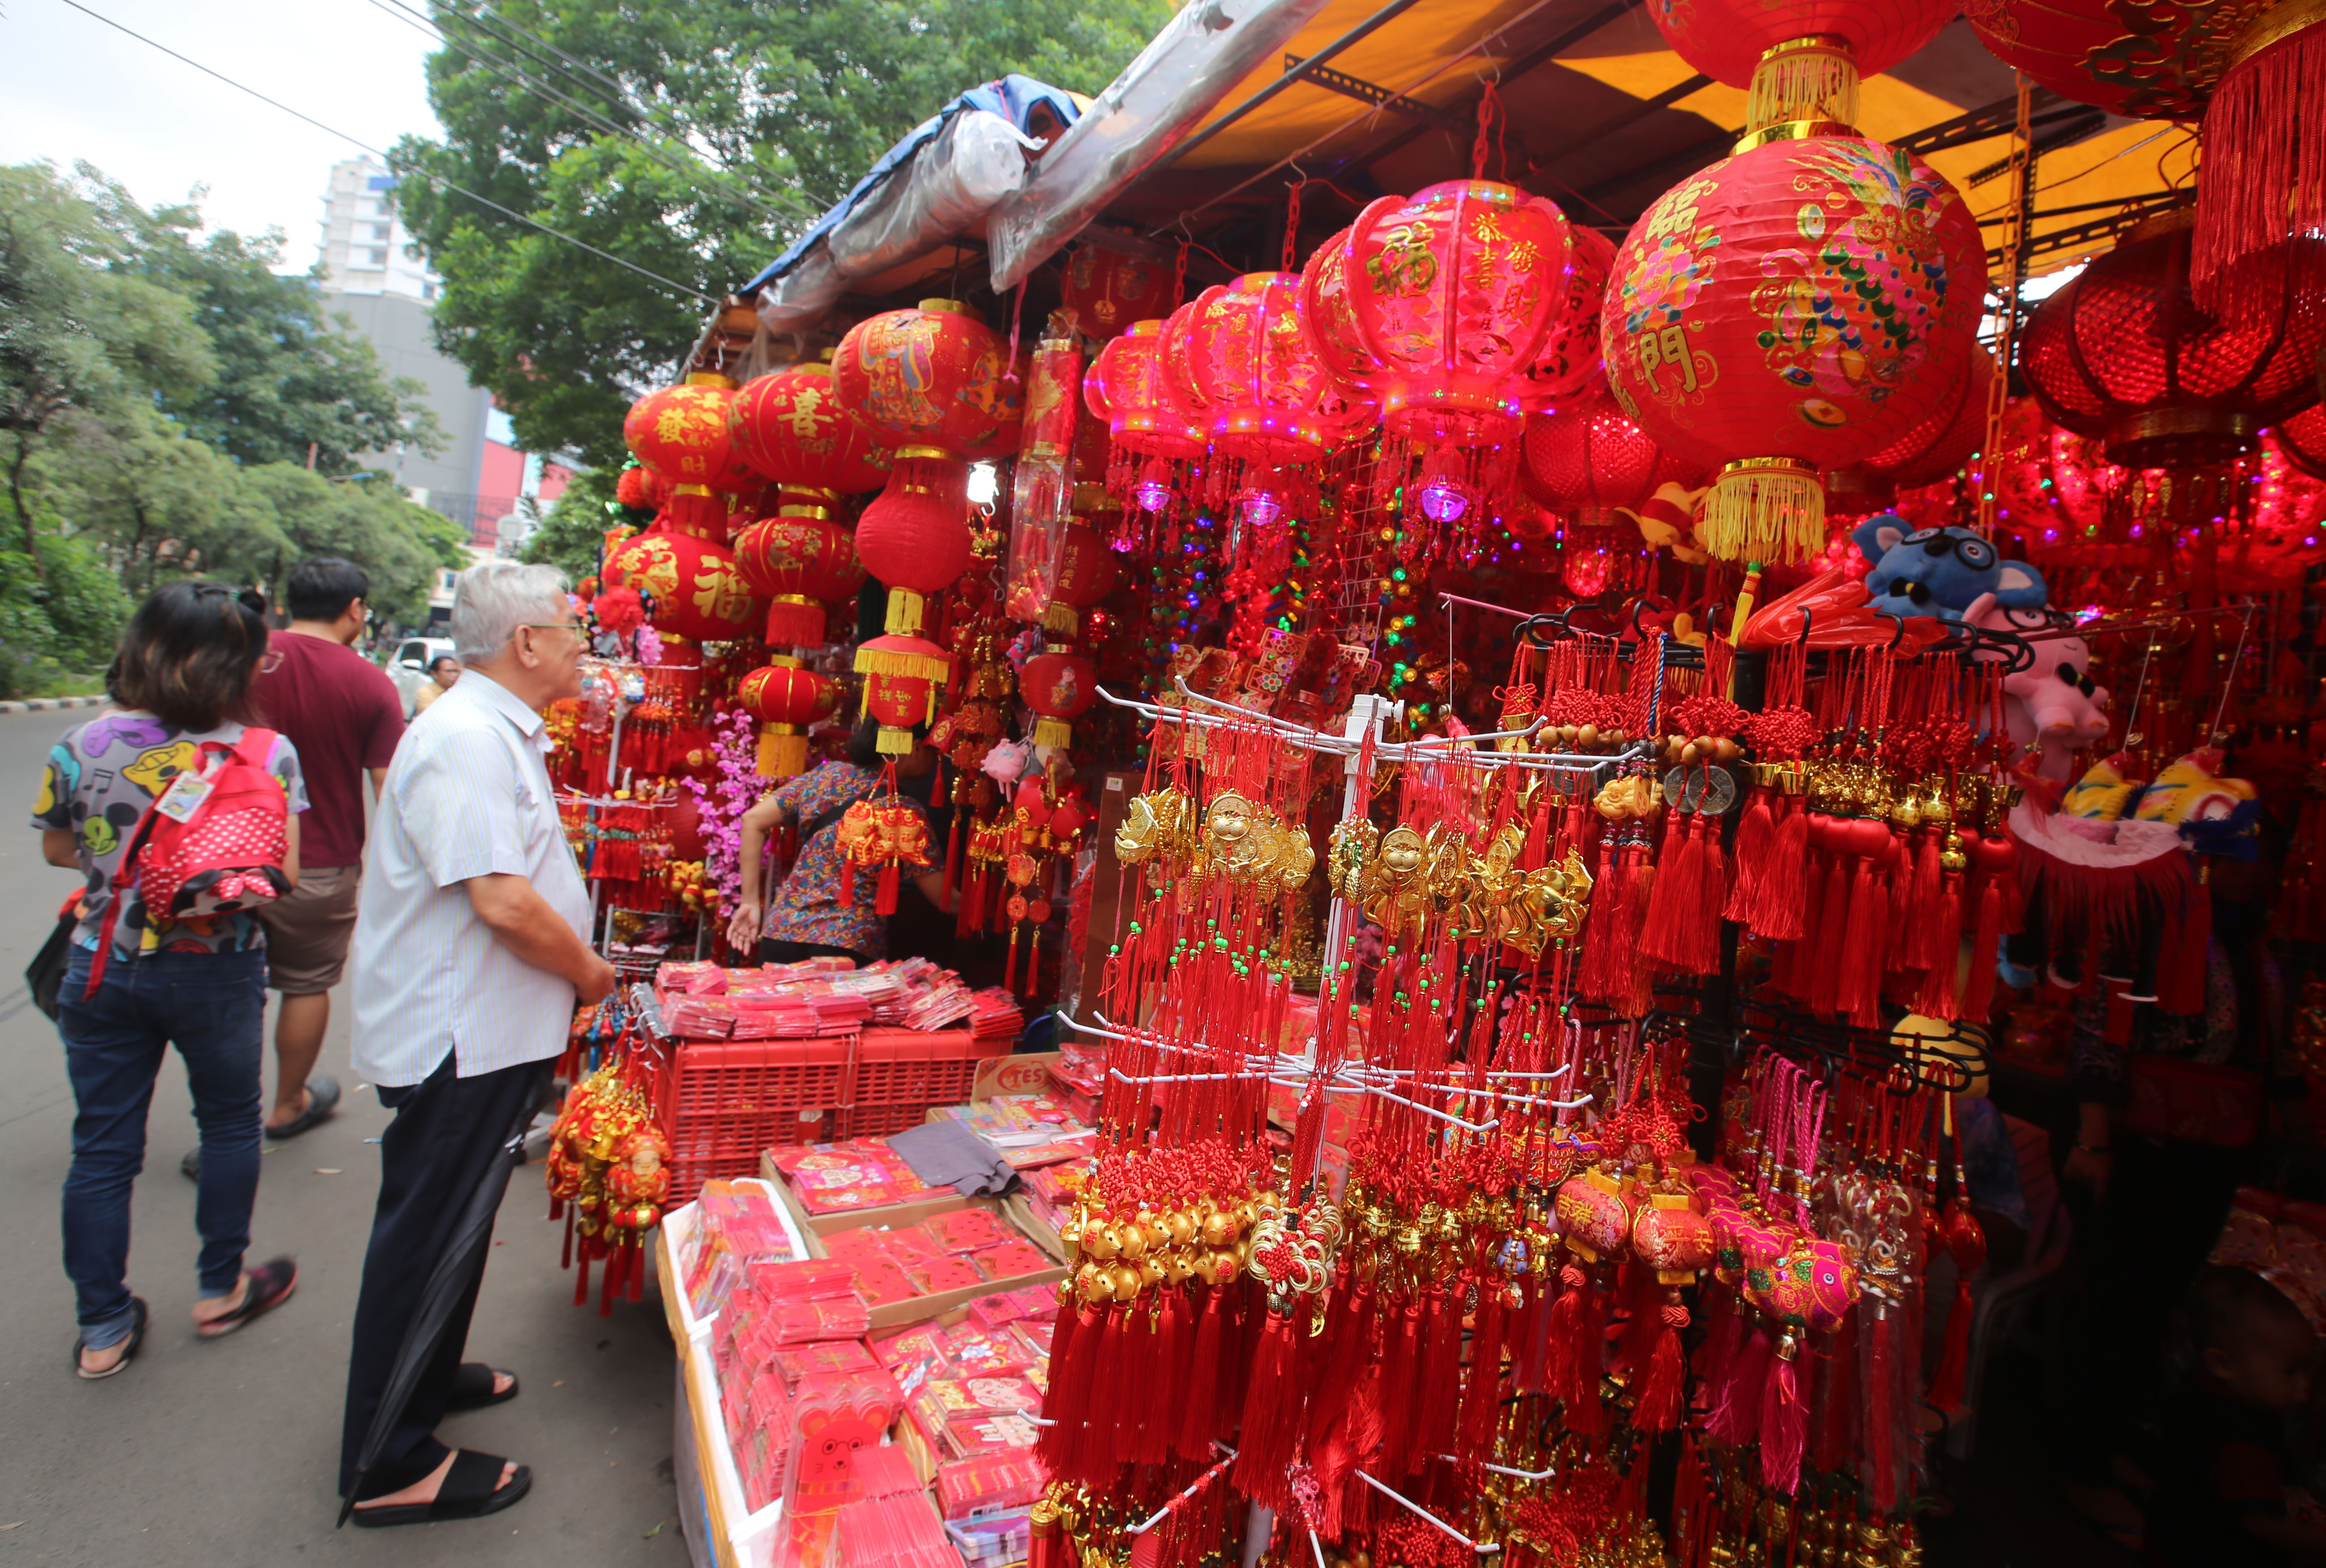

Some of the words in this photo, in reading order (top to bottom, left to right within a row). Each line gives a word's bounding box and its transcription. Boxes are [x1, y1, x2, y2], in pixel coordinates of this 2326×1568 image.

[1464, 212, 1513, 289] 恭喜
[1497, 240, 1549, 327] 發財
[692, 554, 756, 625] 福
[1556, 1191, 1595, 1232] 吉祥
